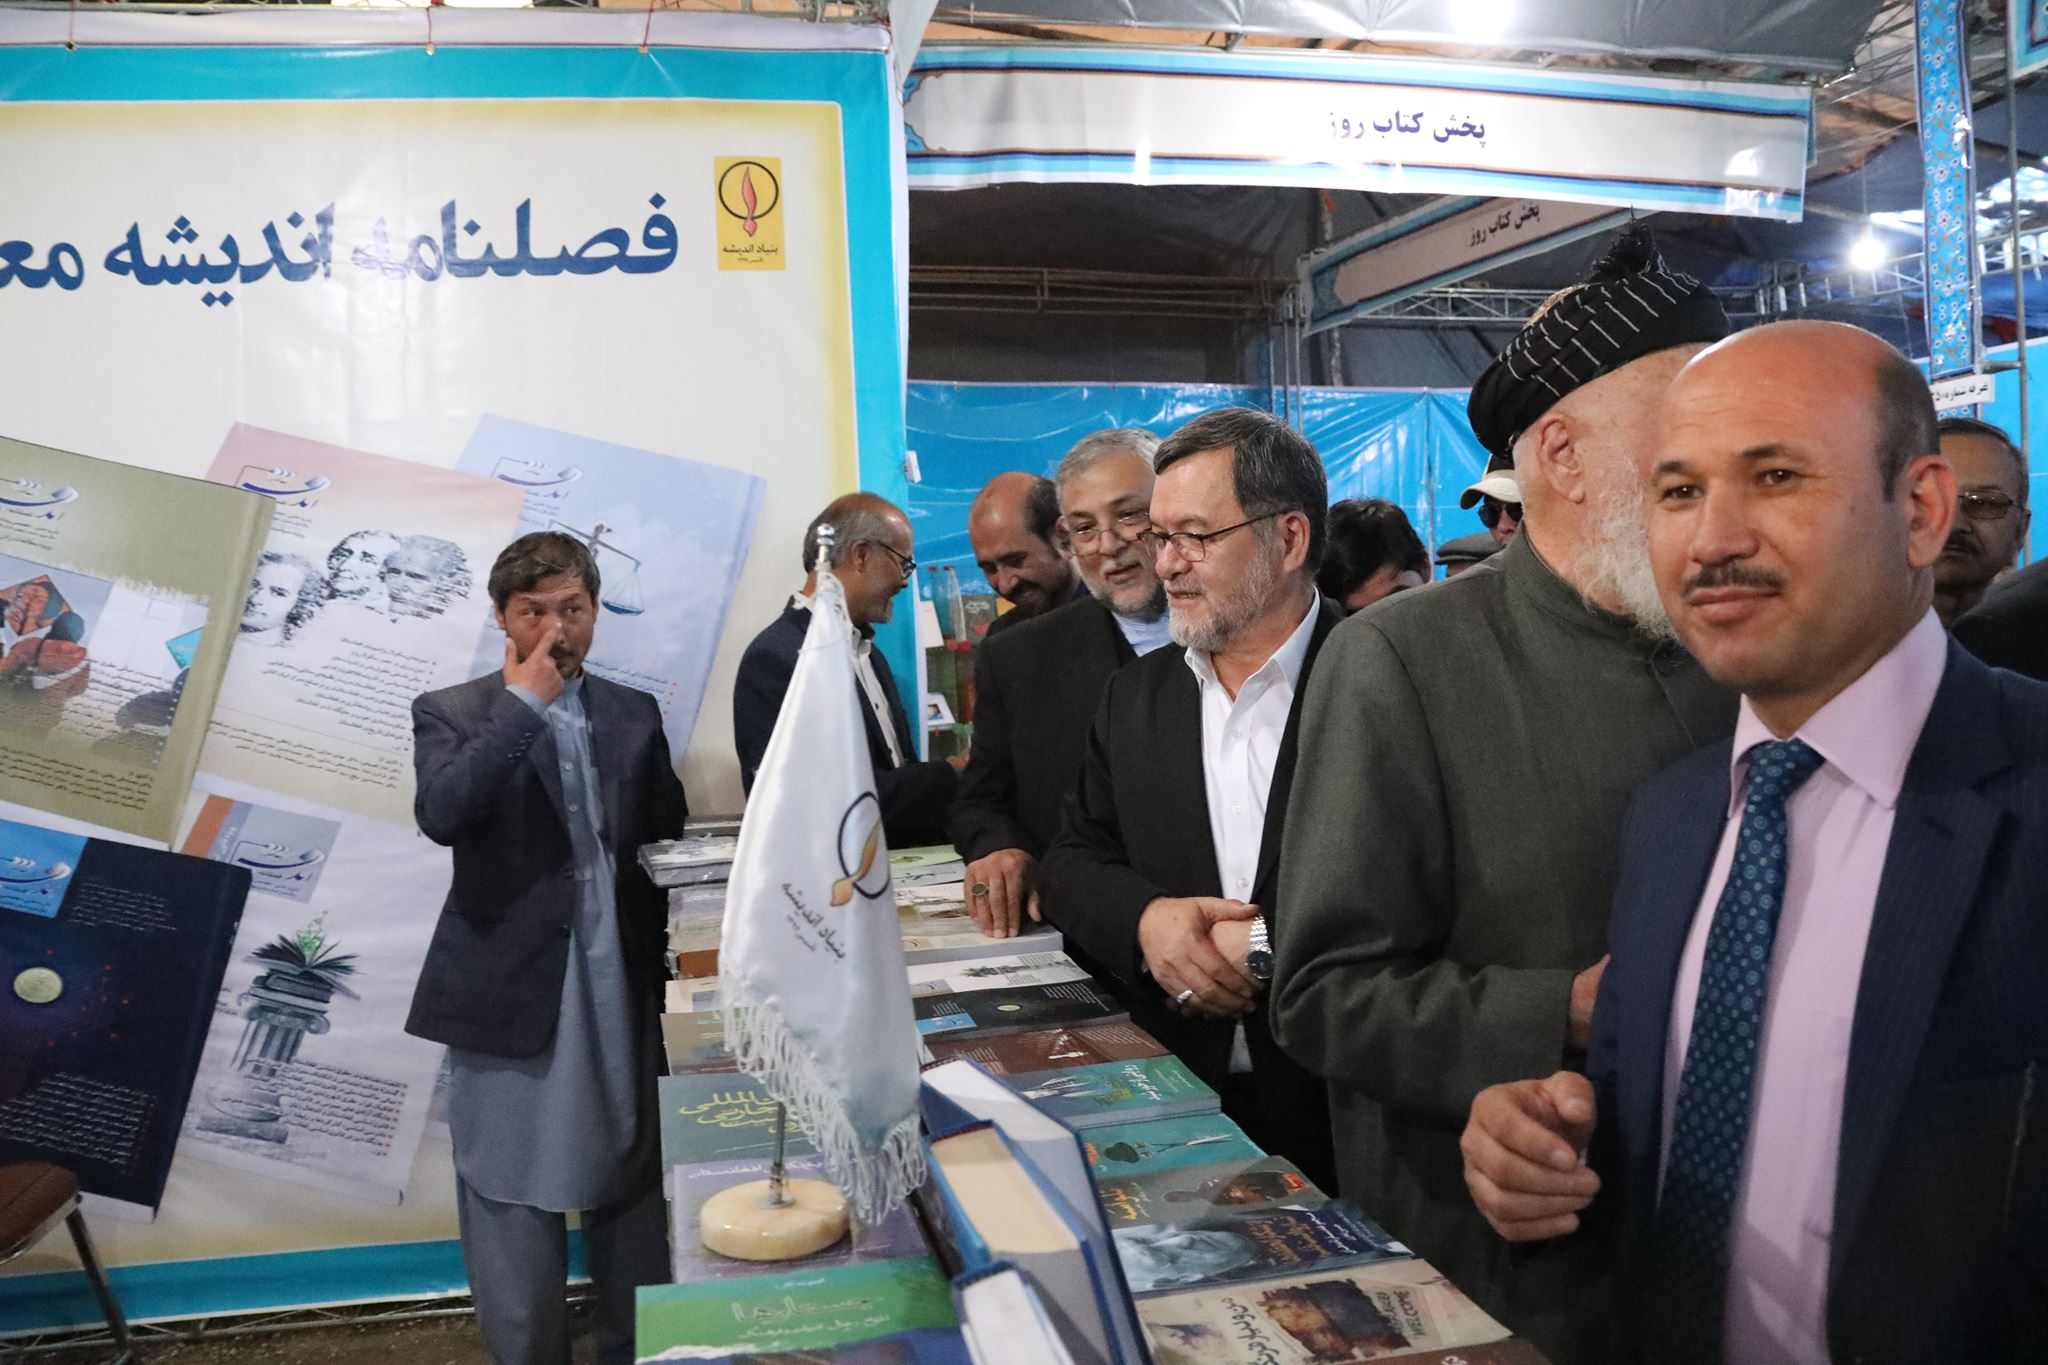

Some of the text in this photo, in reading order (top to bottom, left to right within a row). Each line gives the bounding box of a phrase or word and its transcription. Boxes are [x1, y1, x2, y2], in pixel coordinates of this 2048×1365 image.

[1329, 110, 1487, 148] پخش کتاب روز
[351, 192, 679, 282] فصلنامه
[1470, 202, 1540, 247] پخش کتاب روز
[103, 201, 336, 307] اندیشه
[782, 883, 825, 929] اندیشه
[818, 927, 847, 963] بنیاد
